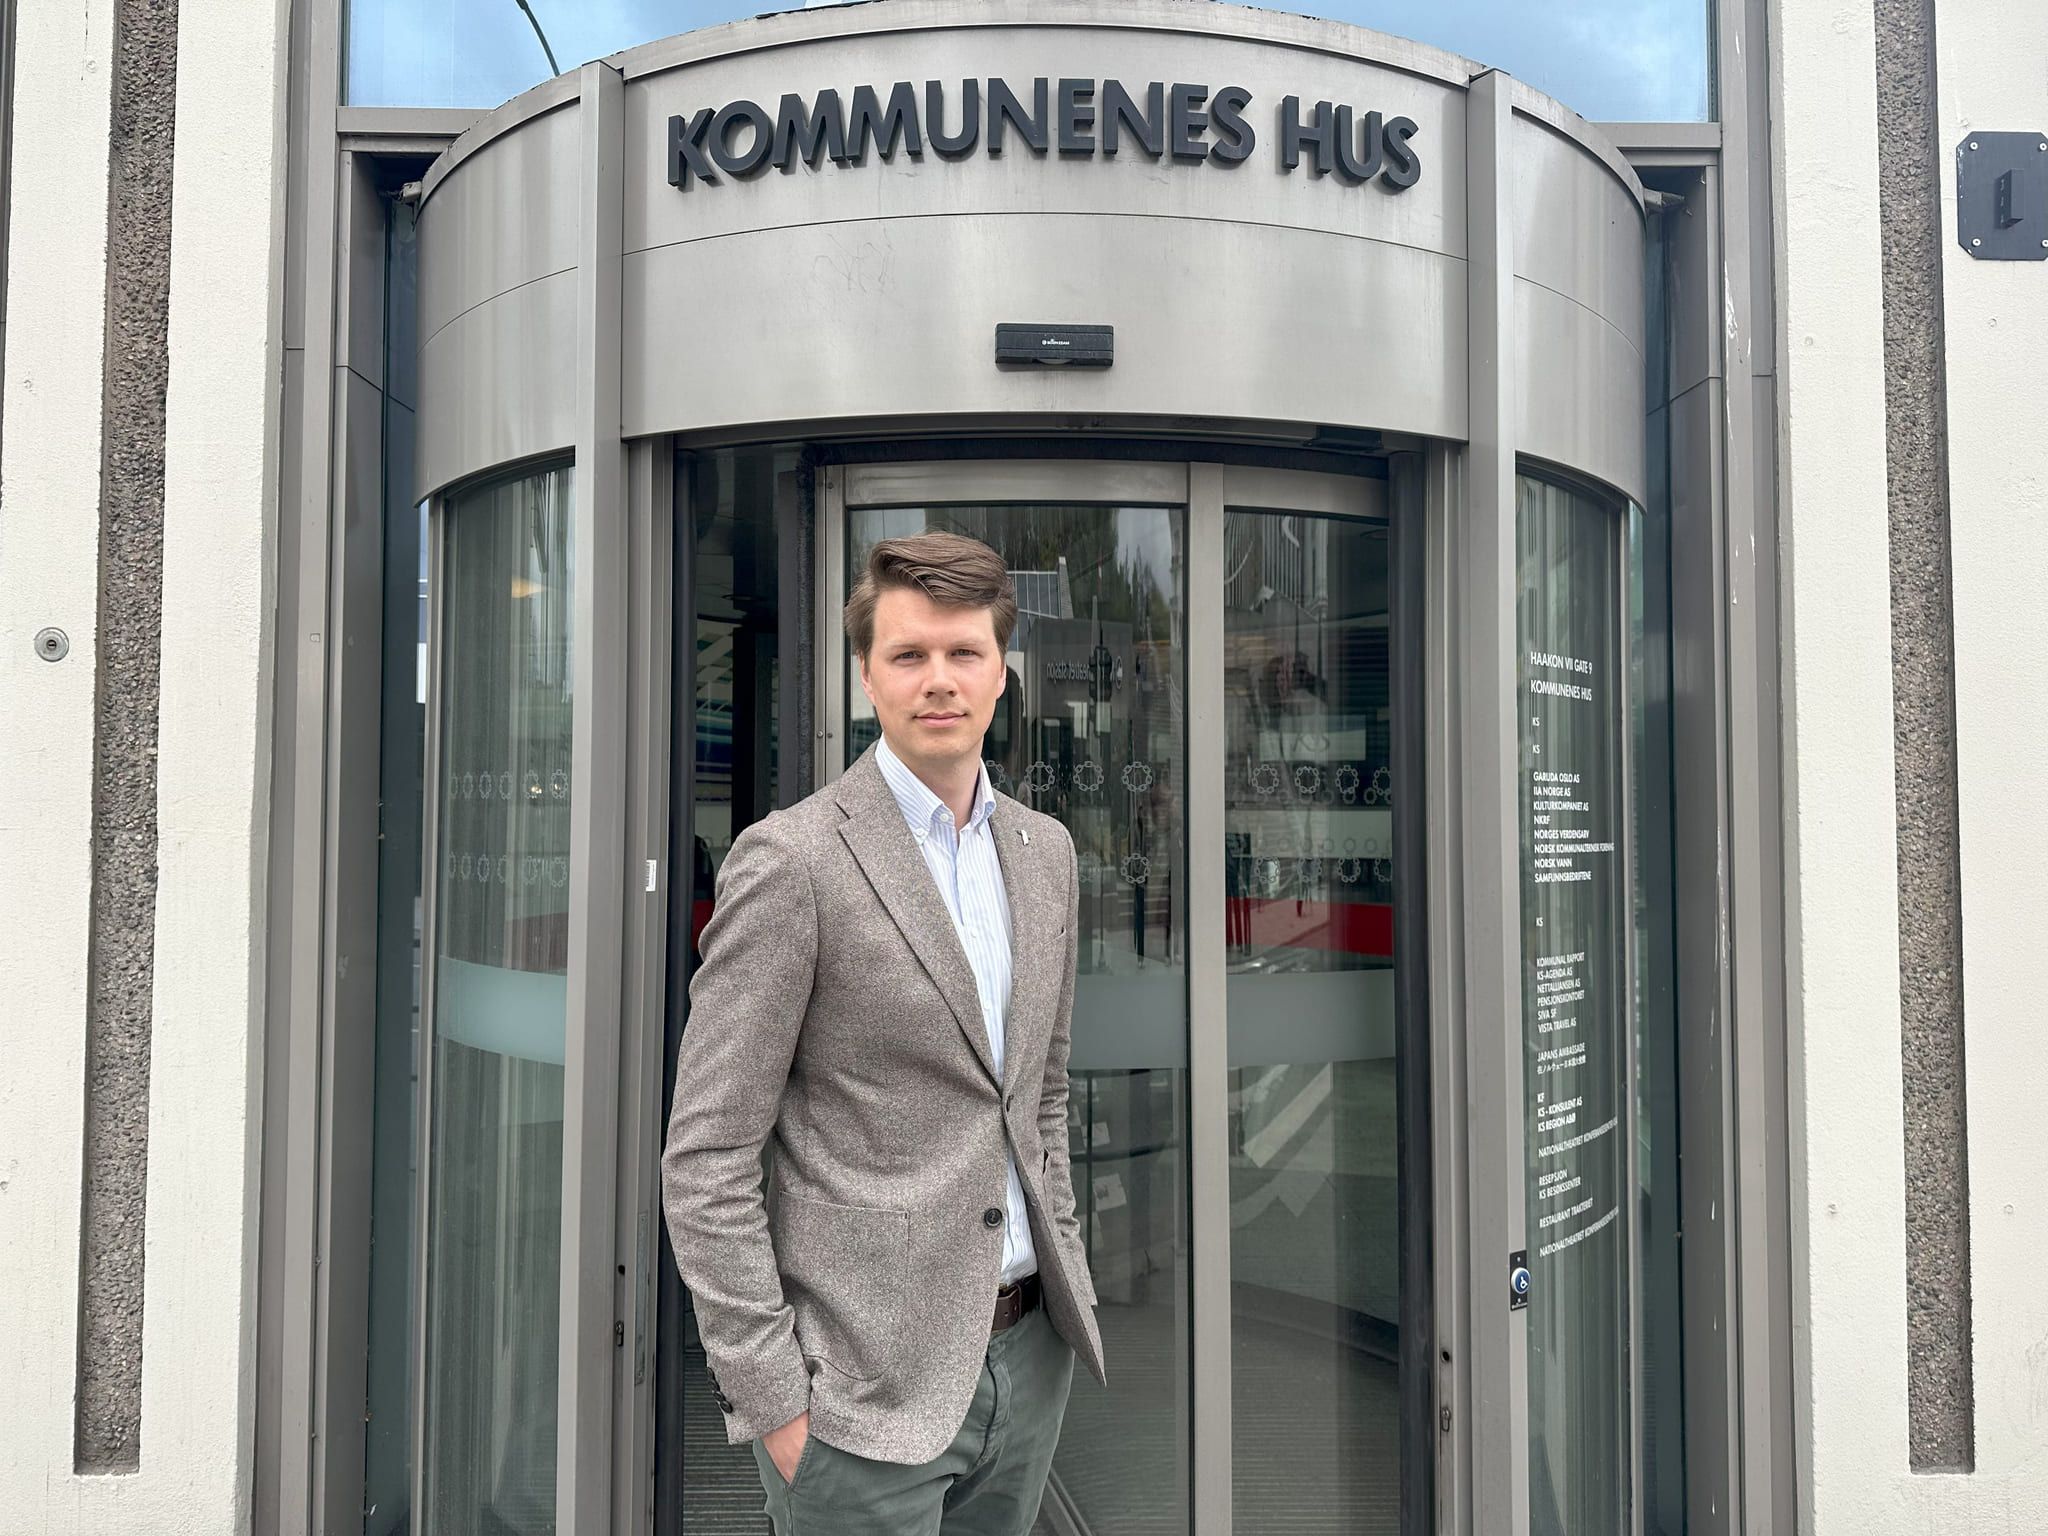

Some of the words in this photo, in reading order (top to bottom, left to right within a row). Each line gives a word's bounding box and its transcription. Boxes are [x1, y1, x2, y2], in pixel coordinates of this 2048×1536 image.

[667, 77, 1257, 189] KOMMUNENES
[1282, 94, 1421, 191] HUS
[1531, 651, 1563, 669] HAAKON
[1565, 657, 1573, 671] VII
[1574, 659, 1588, 674] GATE
[1589, 662, 1592, 675] 9
[1531, 680, 1580, 698] KOMMUNENES
[1582, 687, 1592, 701] HUS
[1532, 717, 1540, 727] KS
[1532, 744, 1540, 754] KS
[1533, 772, 1558, 782] GARUDA
[1559, 773, 1573, 783] OSLO
[1573, 774, 1580, 783] AS
[1543, 786, 1563, 796] NORGE
[1564, 788, 1571, 796] AS
[1583, 802, 1589, 811] AS
[1534, 829, 1559, 839] NORGES
[1560, 830, 1589, 839] VERDENSARV
[1534, 844, 1555, 854] NORSK
[1535, 858, 1555, 868] NORSK
[1556, 858, 1572, 867] VANN
[1536, 917, 1543, 927] KS
[1537, 956, 1566, 967] KOMMUNAL
[1567, 952, 1584, 963] RAPPORT
[1537, 968, 1566, 980] KS-AGENDA
[1567, 967, 1573, 976] AS
[1575, 978, 1581, 987] AS
[1538, 1009, 1550, 1020] SIVA
[1538, 1022, 1553, 1033] VISTA
[1554, 1019, 1570, 1030] TRAVEL
[1571, 1017, 1576, 1027] AS
[1537, 1049, 1558, 1062] JAPANS
[1538, 1107, 1545, 1117] KS
[1549, 1098, 1576, 1114] KONSULENT
[1577, 1096, 1582, 1106] AS
[1538, 1121, 1545, 1133] KS
[1546, 1116, 1565, 1131] REGION
[1539, 1169, 1568, 1186] RESEPSJON
[1539, 1190, 1546, 1200] KS
[1539, 1208, 1571, 1228] RESTAURANT
